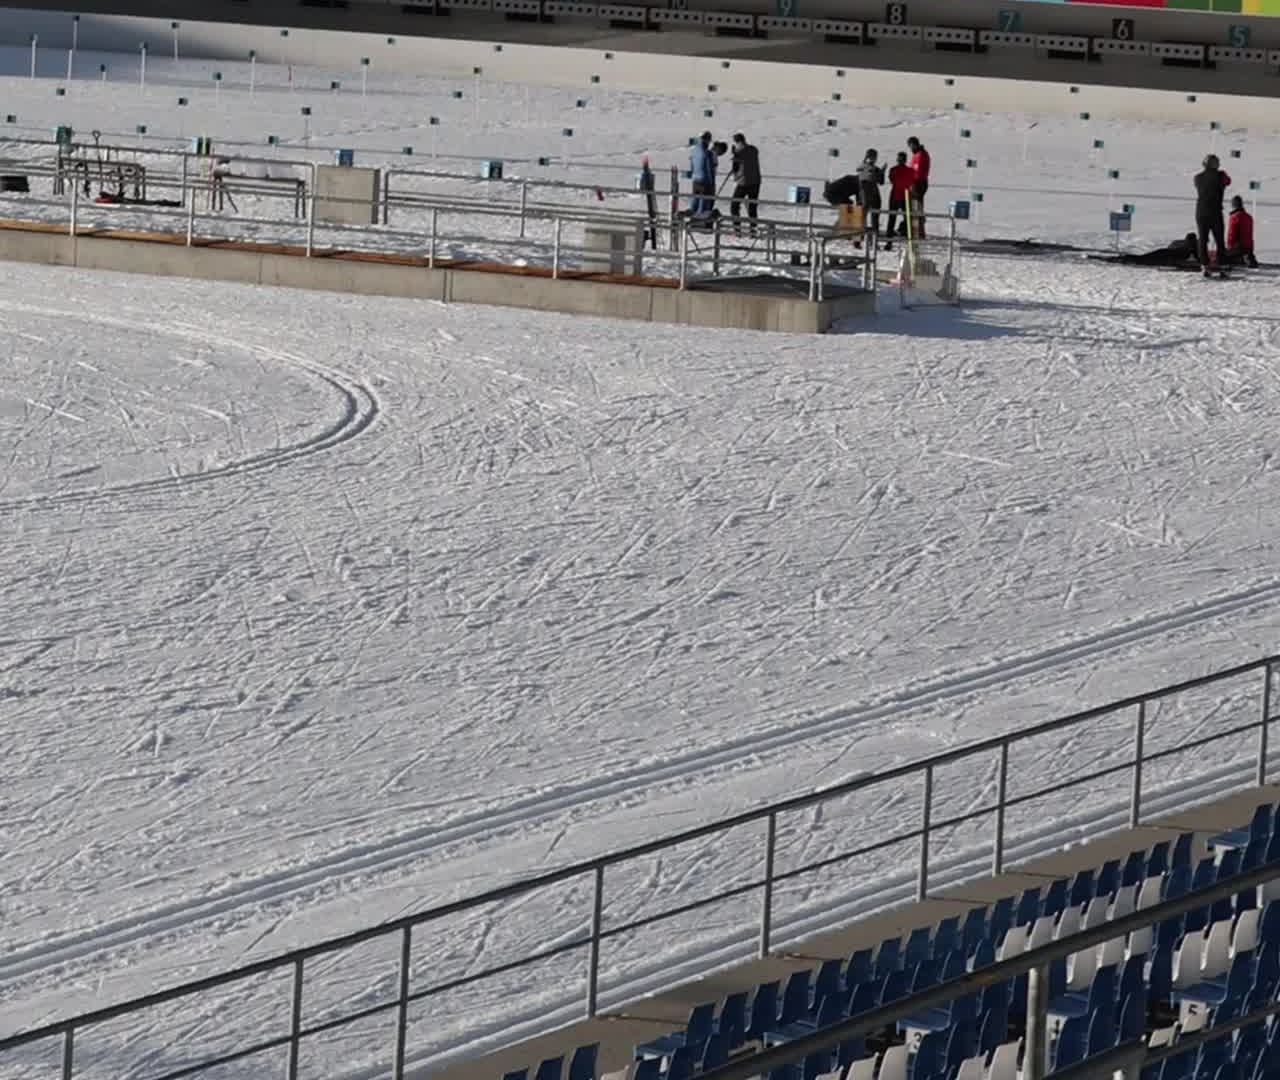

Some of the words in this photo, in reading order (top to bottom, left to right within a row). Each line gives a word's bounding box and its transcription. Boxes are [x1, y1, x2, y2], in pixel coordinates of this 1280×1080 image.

[890, 4, 902, 24] 8
[1000, 10, 1014, 32] 7
[1117, 21, 1129, 40] 6
[1232, 25, 1245, 46] 5
